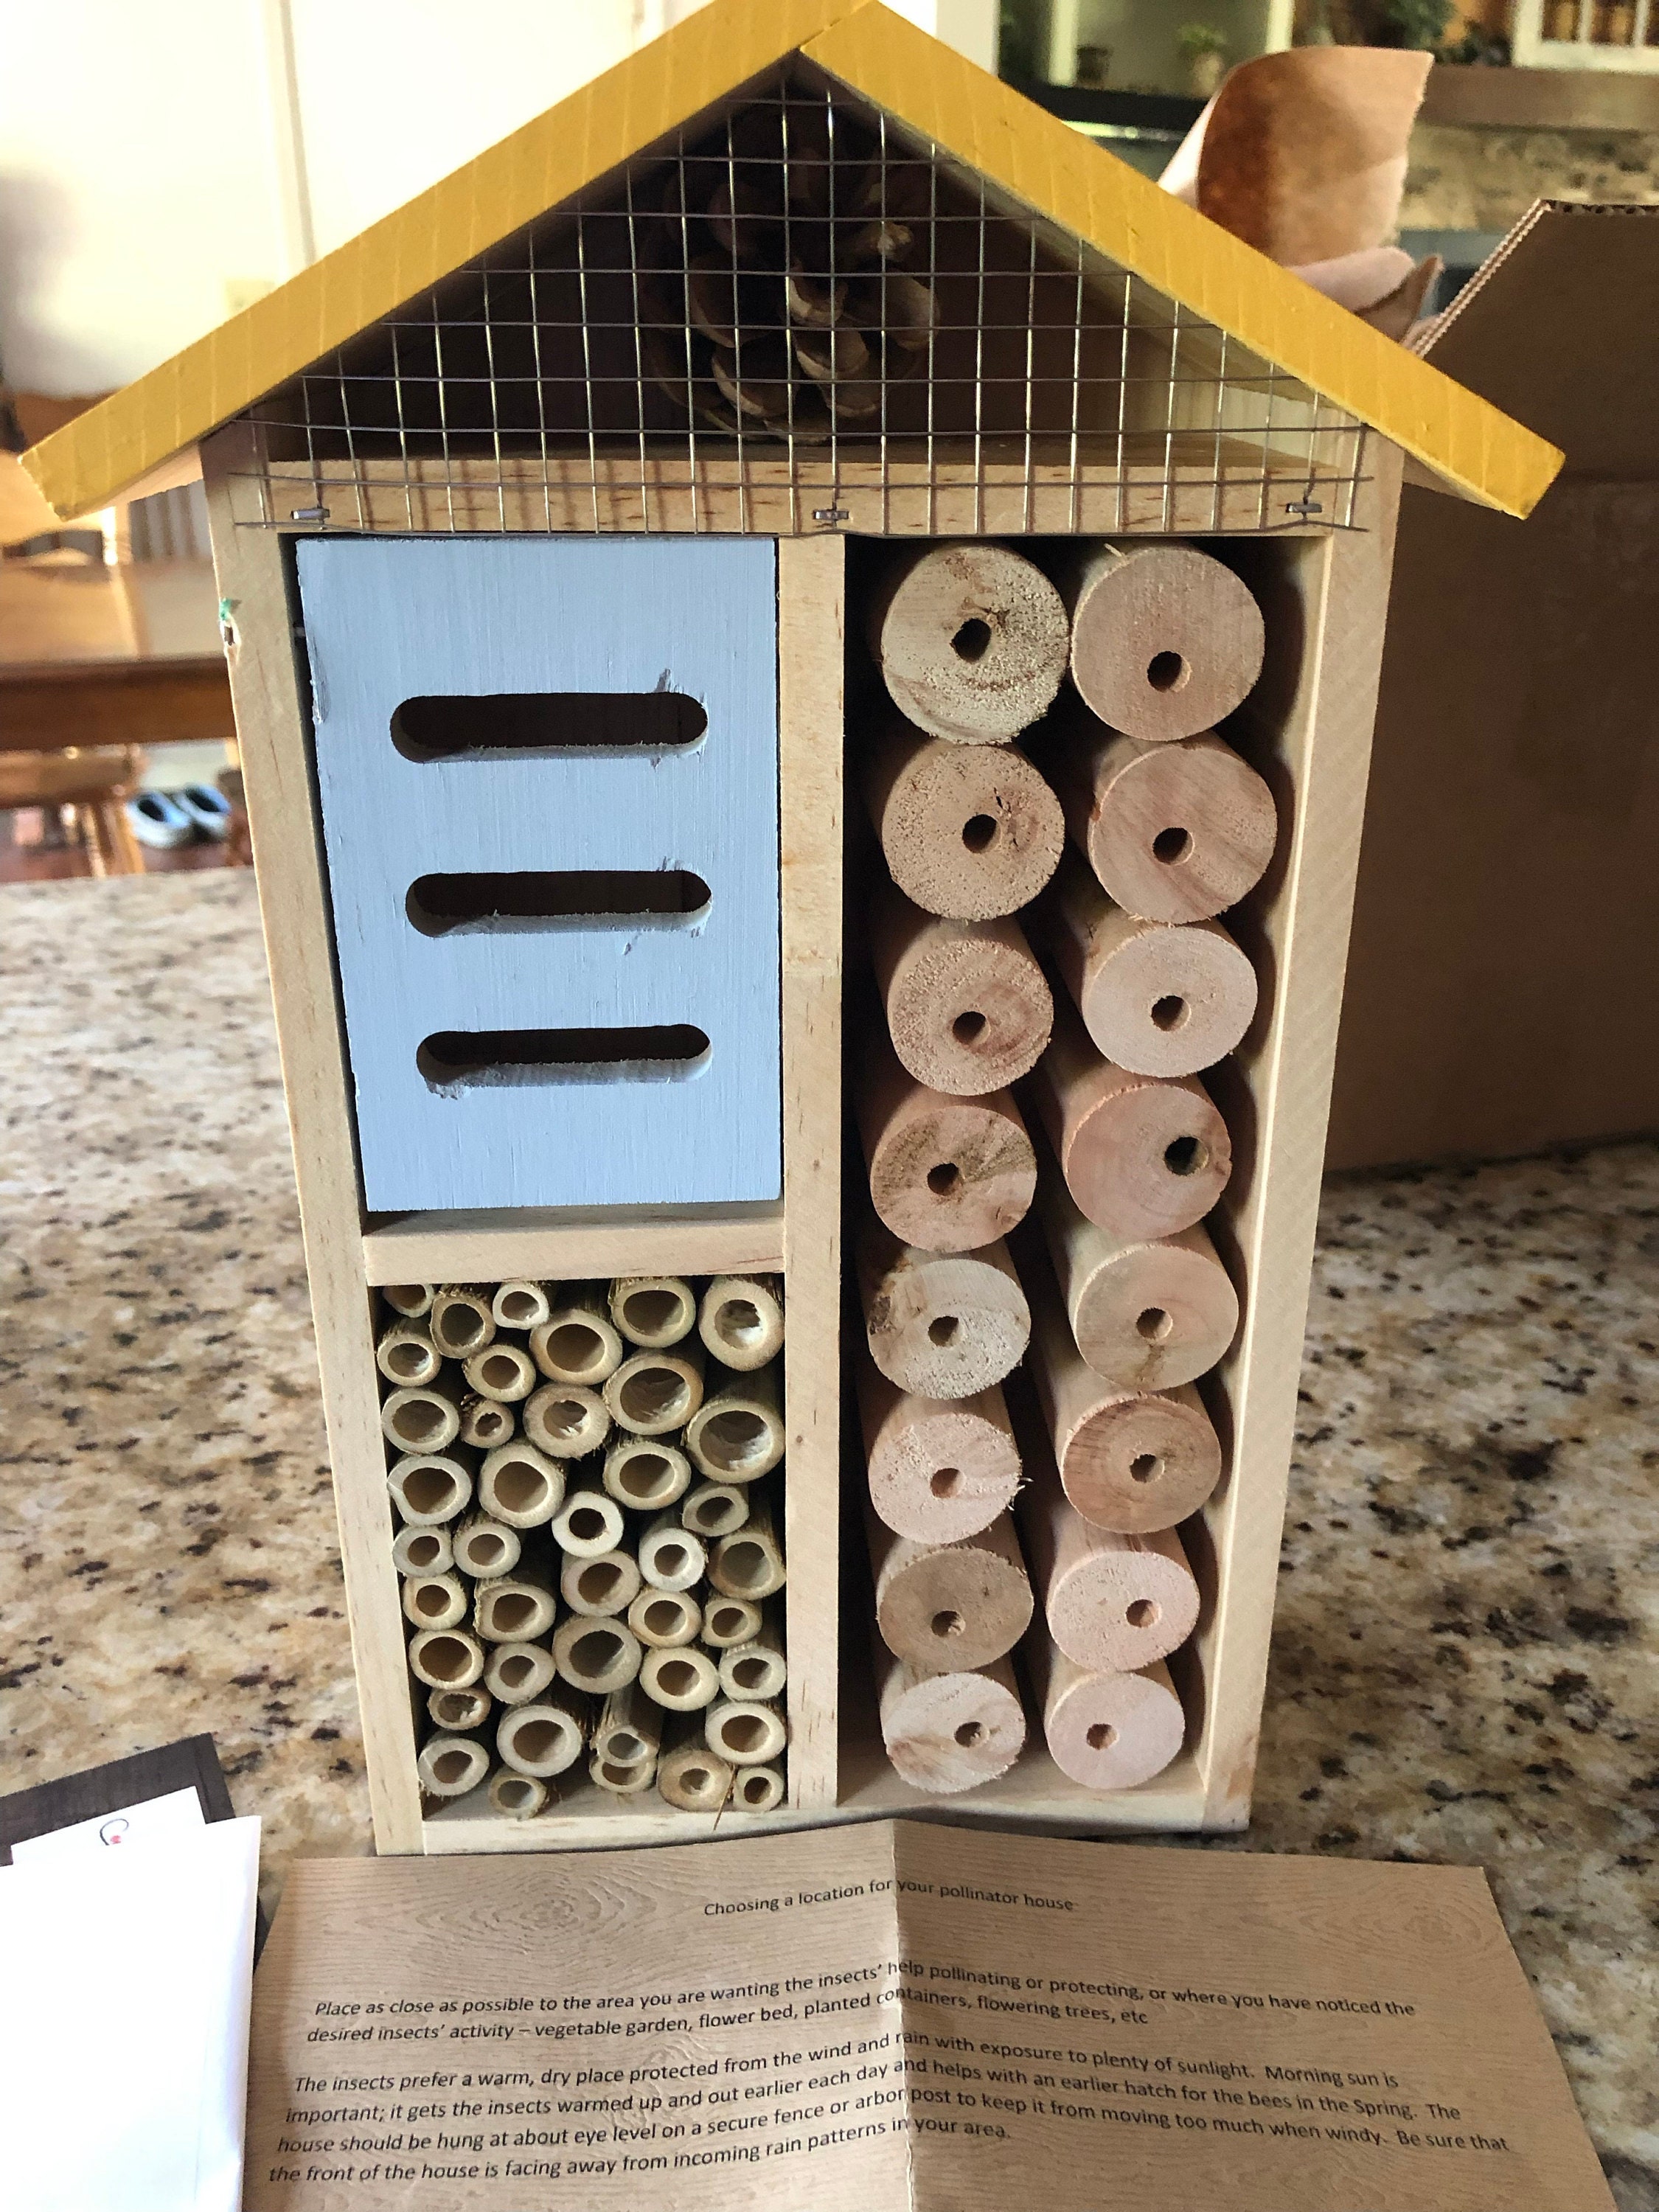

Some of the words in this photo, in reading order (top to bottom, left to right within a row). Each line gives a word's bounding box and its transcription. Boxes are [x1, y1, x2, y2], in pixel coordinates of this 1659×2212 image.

[704, 1898, 779, 1916] Choosing
[785, 1896, 793, 1907] a
[799, 1885, 864, 1905] location
[869, 1879, 893, 1893] for
[896, 1879, 934, 1893] your
[939, 1885, 1019, 1905] pollinator
[1023, 1893, 1074, 1911] house
[307, 2025, 375, 2042] desired
[449, 2023, 515, 2041] activity
[535, 2020, 622, 2040] vegetable
[625, 2017, 693, 2037] garden,
[699, 2011, 756, 2028] flower
[760, 2003, 798, 2022] bed,
[804, 1992, 871, 2020] planted
[876, 1986, 973, 2009] containers,
[976, 1994, 1061, 2020] flowering
[1065, 2005, 1116, 2024] trees,
[1120, 2010, 1148, 2024] etc
[315, 2001, 361, 2016] Place
[365, 2003, 385, 2014] as
[389, 1999, 435, 2014] close
[439, 2001, 458, 2012] as
[462, 1997, 534, 2015] possible
[540, 1997, 557, 2011] to
[563, 1996, 591, 2011] the
[597, 1997, 634, 2008] area
[639, 1994, 672, 2011] you
[677, 1992, 706, 2004] are
[710, 1982, 779, 2000] wanting
[785, 1977, 813, 1992] the
[888, 1959, 925, 1978] help
[929, 1966, 1022, 1991] pollinating
[1025, 1978, 1044, 1989] or
[1049, 1980, 1144, 2001] protecting,
[1149, 1989, 1167, 2000] or
[1171, 1988, 1228, 2006] where
[1231, 1995, 1265, 2009] you
[1268, 1994, 1311, 2010] have
[1315, 1999, 1382, 2014] noticed
[1385, 2000, 1415, 2016] the
[285, 2106, 385, 2126] important;
[390, 2104, 403, 2119] it
[406, 2103, 446, 2122] gets
[453, 2099, 483, 2117] the
[487, 2099, 552, 2115] insects
[557, 2095, 633, 2113] warmed
[639, 2096, 662, 2115] up
[668, 2090, 703, 2108] and
[708, 2087, 739, 2104] out
[744, 2080, 803, 2099] earlier
[808, 2070, 850, 2090] each
[856, 2064, 888, 2081] day
[894, 2058, 928, 2073] and
[933, 2059, 981, 2081] helps
[987, 2069, 1028, 2084] with
[1033, 2074, 1056, 2088] an
[1060, 2076, 1119, 2093] earlier
[1124, 2079, 1177, 2099] hatch
[1180, 2084, 1207, 2101] for
[1212, 2088, 1243, 2105] the
[1248, 2090, 1293, 2109] bees
[1295, 2094, 1315, 2110] in
[1318, 2096, 1349, 2112] the
[1353, 2098, 1418, 2121] Spring.
[1425, 2103, 1461, 2120] The
[296, 2076, 327, 2092] The
[332, 2075, 394, 2091] insects
[399, 2071, 458, 2092] prefer
[462, 2074, 472, 2087] a
[478, 2073, 535, 2087] warm,
[540, 2068, 571, 2087] dry
[576, 2067, 625, 2087] place
[630, 2059, 718, 2085] protected
[724, 2057, 767, 2073] from
[773, 2051, 802, 2067] the
[808, 2041, 852, 2062] wind
[858, 2033, 889, 2054] and
[896, 2032, 930, 2052] rain
[934, 2037, 975, 2052] with
[980, 2043, 1062, 2061] exposure
[1067, 2049, 1088, 2064] to
[1092, 2050, 1149, 2073] plenty
[1153, 2056, 1172, 2073] of
[1178, 2060, 1255, 2081] sunlight.
[1265, 2065, 1344, 2088] Morning
[1347, 2073, 1380, 2087] sun
[1382, 2072, 1399, 2088] is
[269, 2166, 301, 2183] the
[306, 2166, 355, 2181] front
[359, 2163, 381, 2182] of
[385, 2164, 416, 2180] the
[421, 2163, 480, 2180] house
[484, 2161, 498, 2178] is
[505, 2159, 562, 2179] facing
[566, 2160, 617, 2176] away
[622, 2155, 667, 2171] from
[674, 2145, 760, 2168] incoming
[766, 2139, 801, 2157] rain
[808, 2123, 886, 2152] patterns
[892, 2118, 908, 2132] in
[914, 2118, 958, 2133] your
[964, 2122, 1011, 2138] area.
[277, 2137, 335, 2153] house
[339, 2134, 403, 2152] should
[408, 2133, 432, 2151] be
[437, 2132, 484, 2152] hung
[490, 2132, 509, 2147] at
[513, 2128, 569, 2146] about
[574, 2129, 607, 2147] eye
[613, 2123, 656, 2142] level
[661, 2124, 685, 2138] on
[691, 2123, 702, 2135] a
[707, 2115, 768, 2135] secure
[774, 2106, 824, 2124] fence
[830, 2101, 849, 2115] or
[855, 2089, 904, 2110] arbor
[911, 2088, 951, 2104] post
[956, 2092, 976, 2107] to
[981, 2093, 1027, 2115] keep
[1032, 2098, 1046, 2114] it
[1050, 2099, 1096, 2119] from
[1101, 2109, 1171, 2129] moving
[1175, 2112, 1208, 2131] too
[1212, 2118, 1265, 2134] much
[1267, 2121, 1321, 2139] when
[1324, 2127, 1388, 2147] windy.
[1396, 2129, 1421, 2146] Be
[1425, 2135, 1466, 2149] sure
[1470, 2134, 1509, 2152] that
